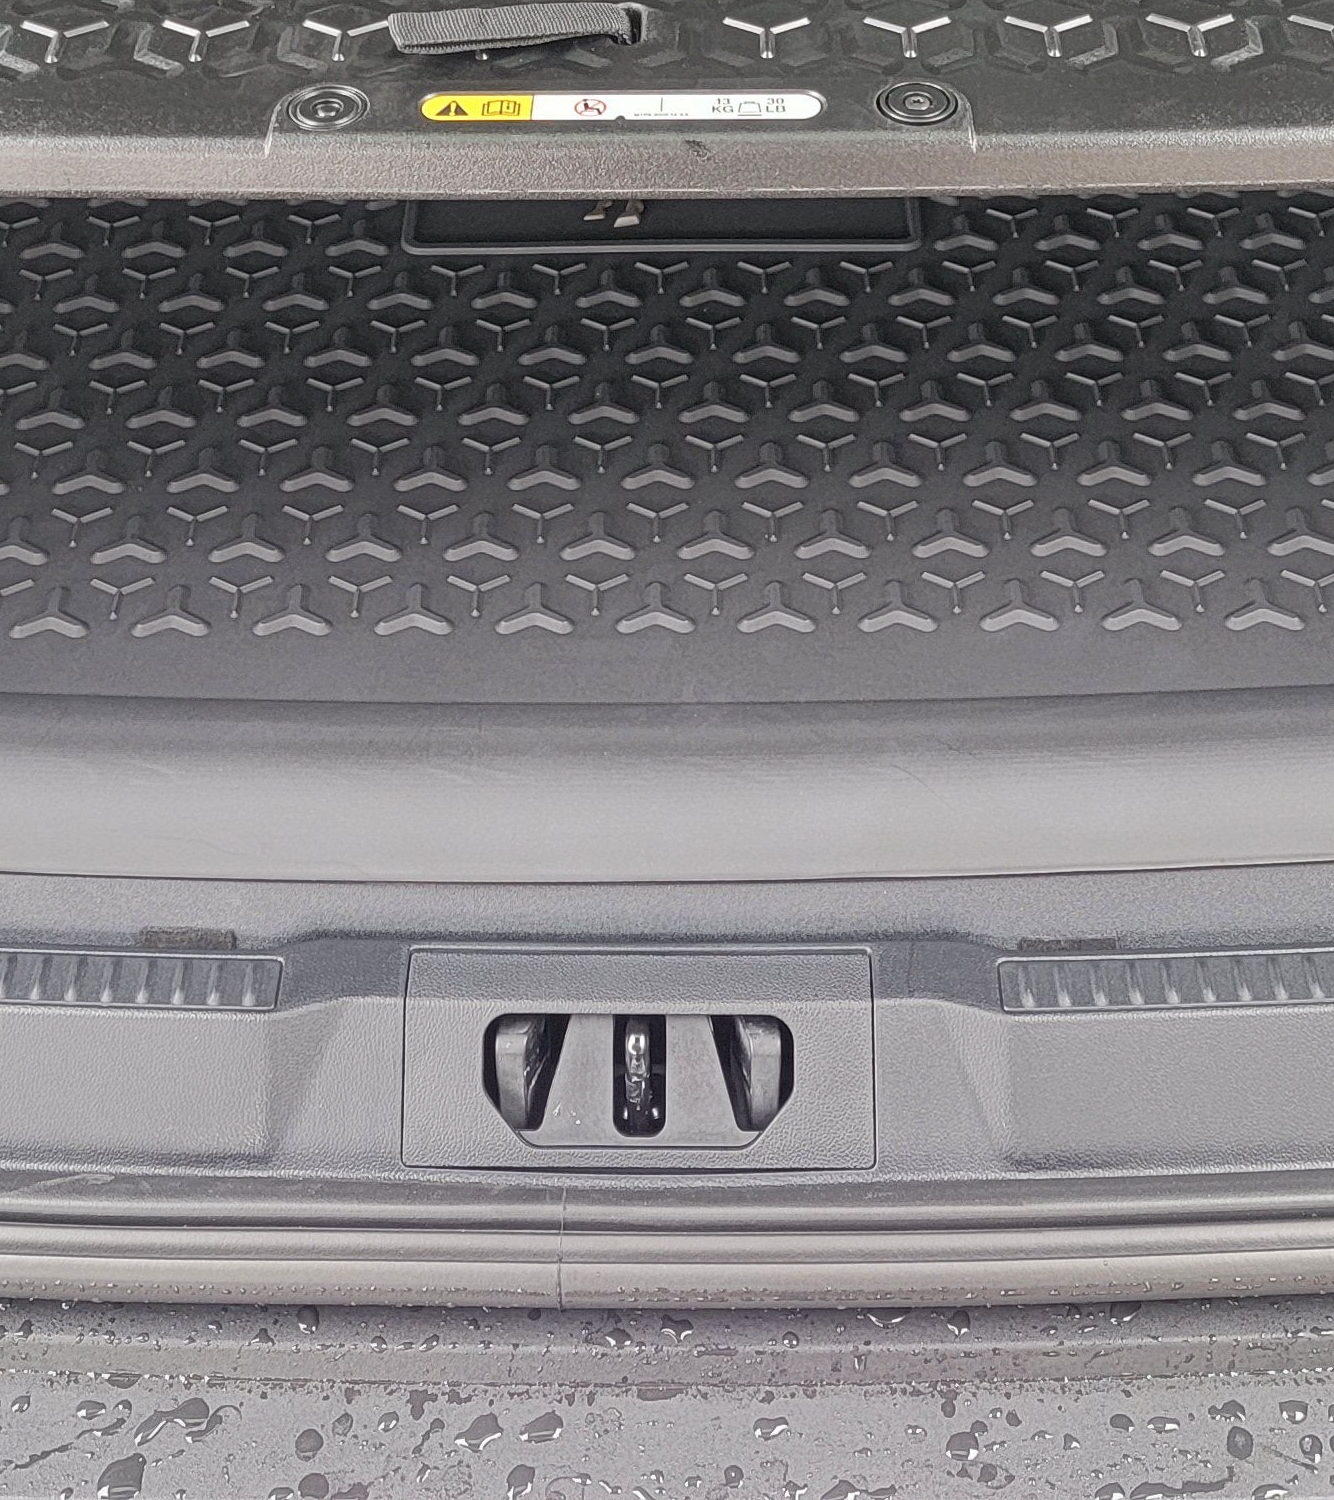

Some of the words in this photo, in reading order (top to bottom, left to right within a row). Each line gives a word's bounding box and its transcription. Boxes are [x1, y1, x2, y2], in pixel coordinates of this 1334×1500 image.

[717, 97, 730, 105] 13
[767, 97, 784, 105] 30
[712, 105, 734, 113] KG
[766, 105, 786, 113] LB
